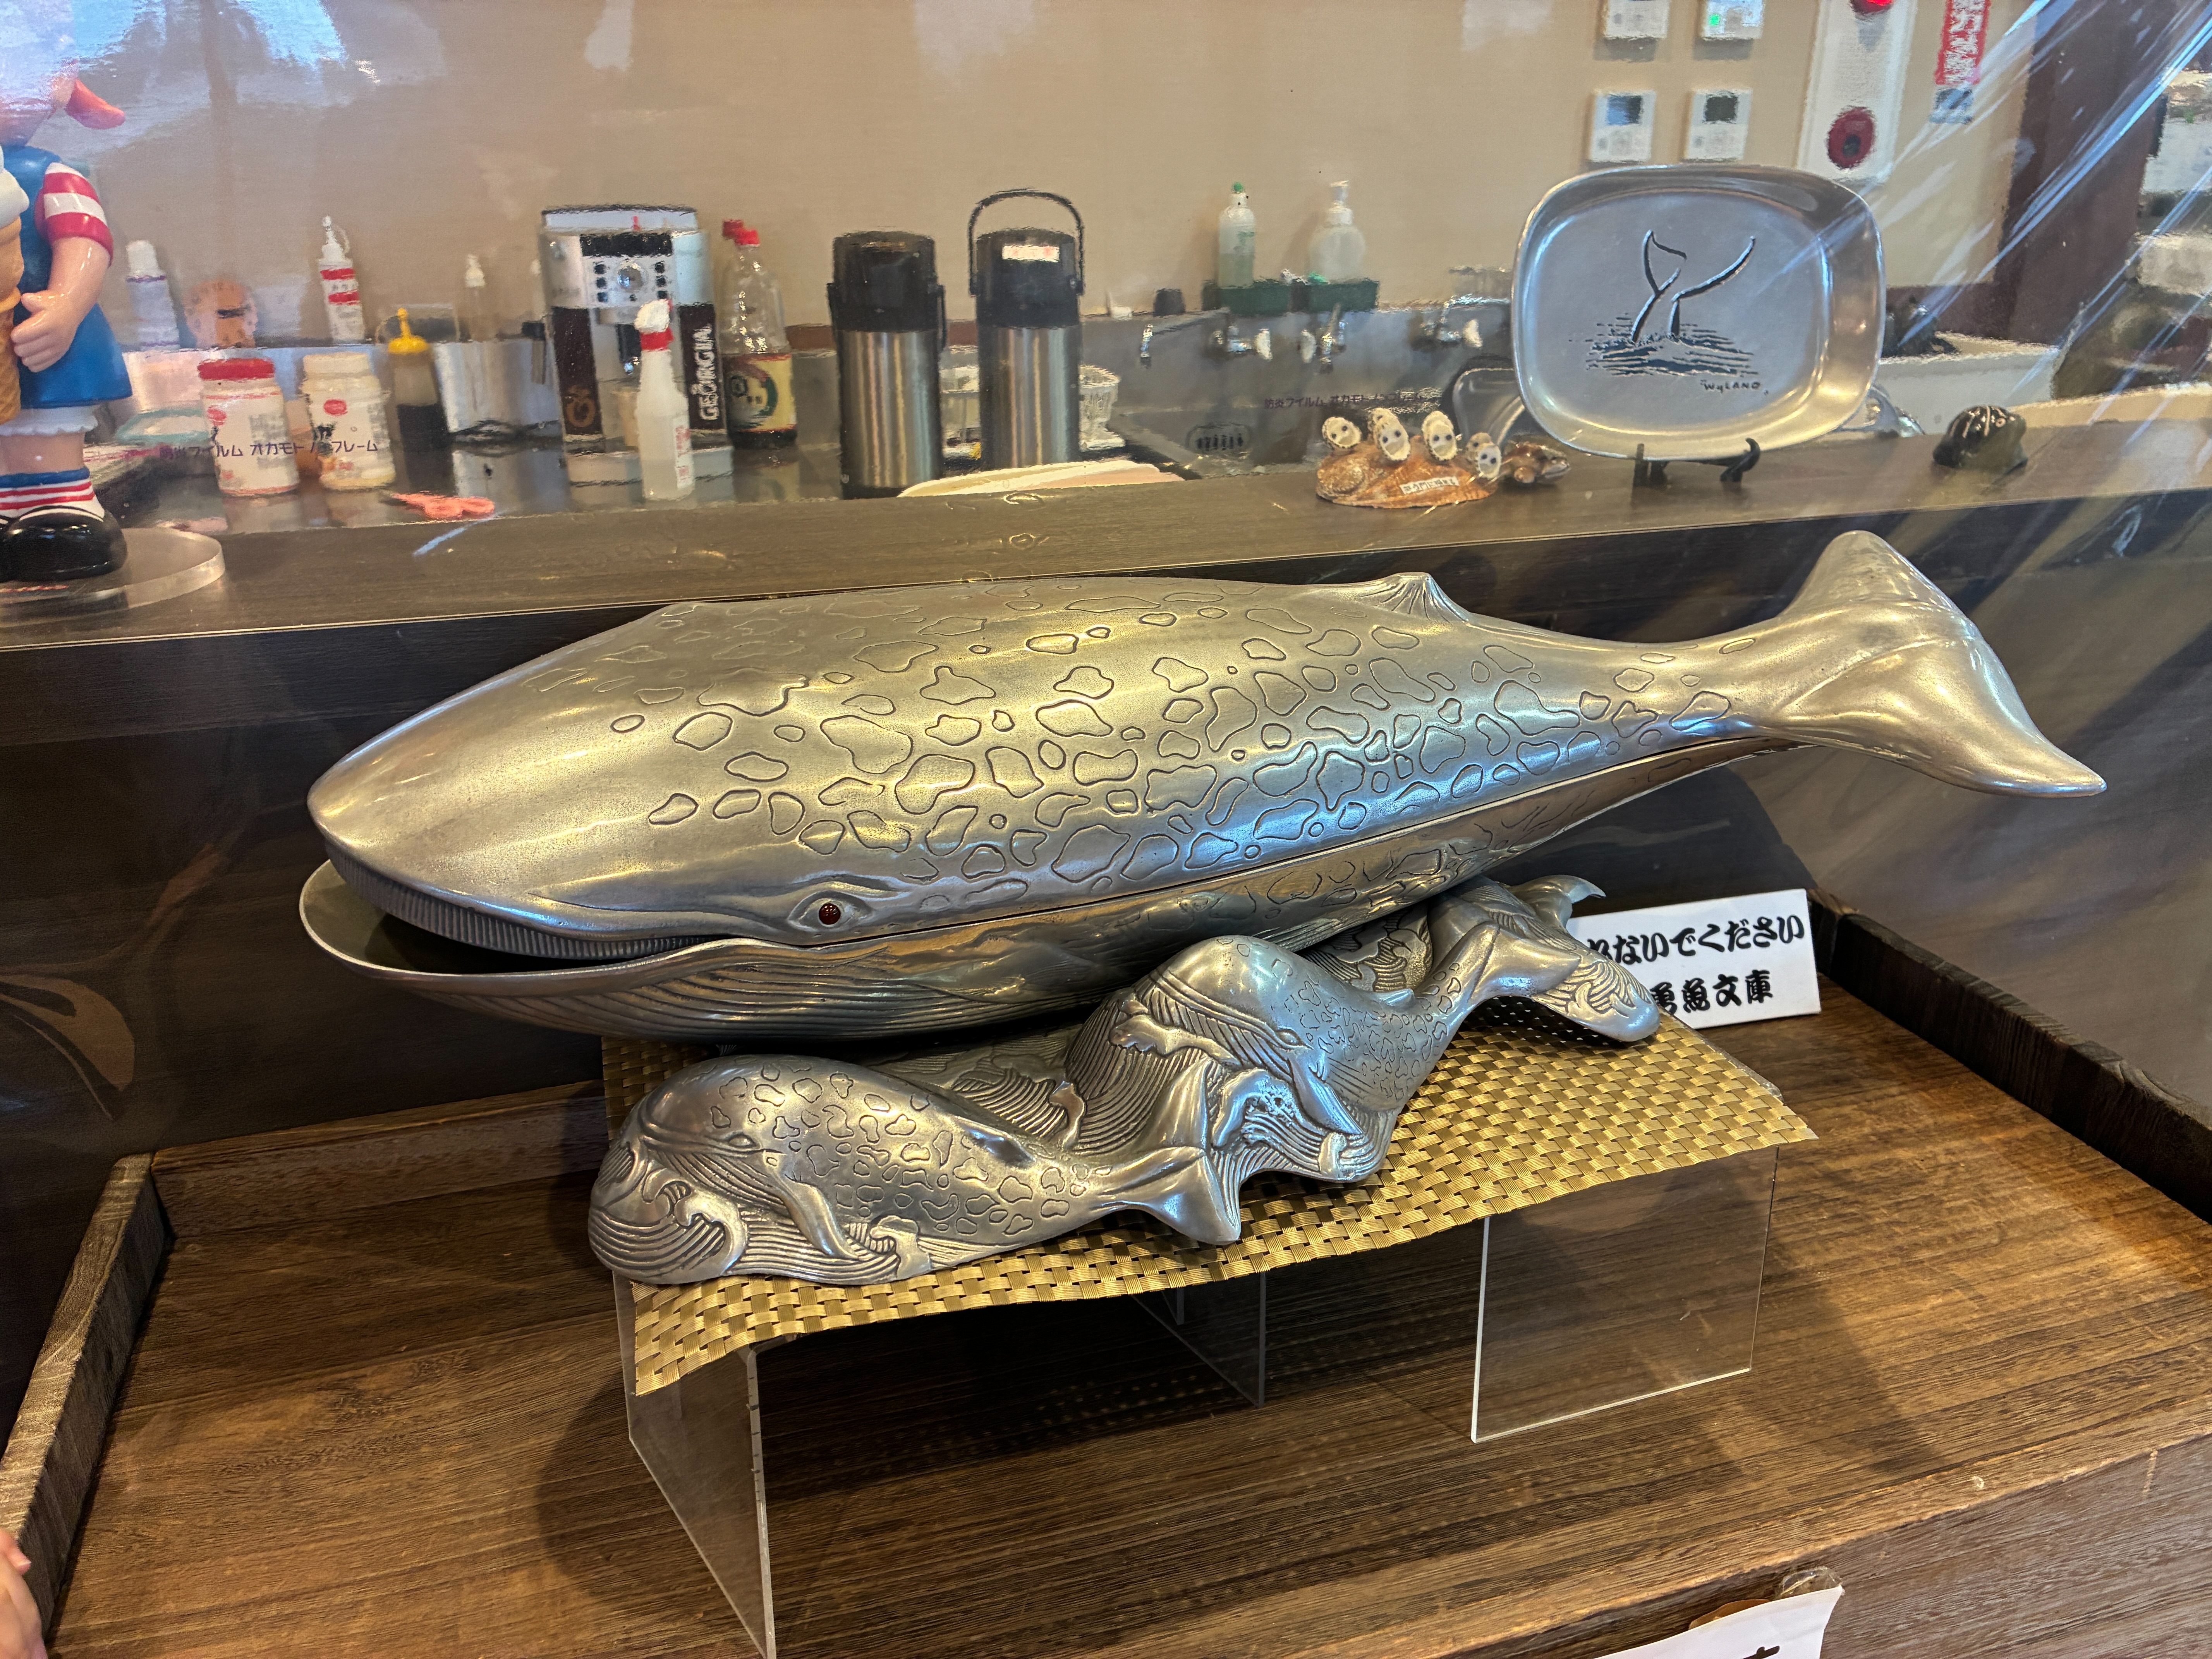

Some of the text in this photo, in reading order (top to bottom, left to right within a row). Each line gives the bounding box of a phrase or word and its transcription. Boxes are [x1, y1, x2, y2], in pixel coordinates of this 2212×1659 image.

[250, 441, 304, 456] オカモト
[310, 440, 378, 454] ノフレーム
